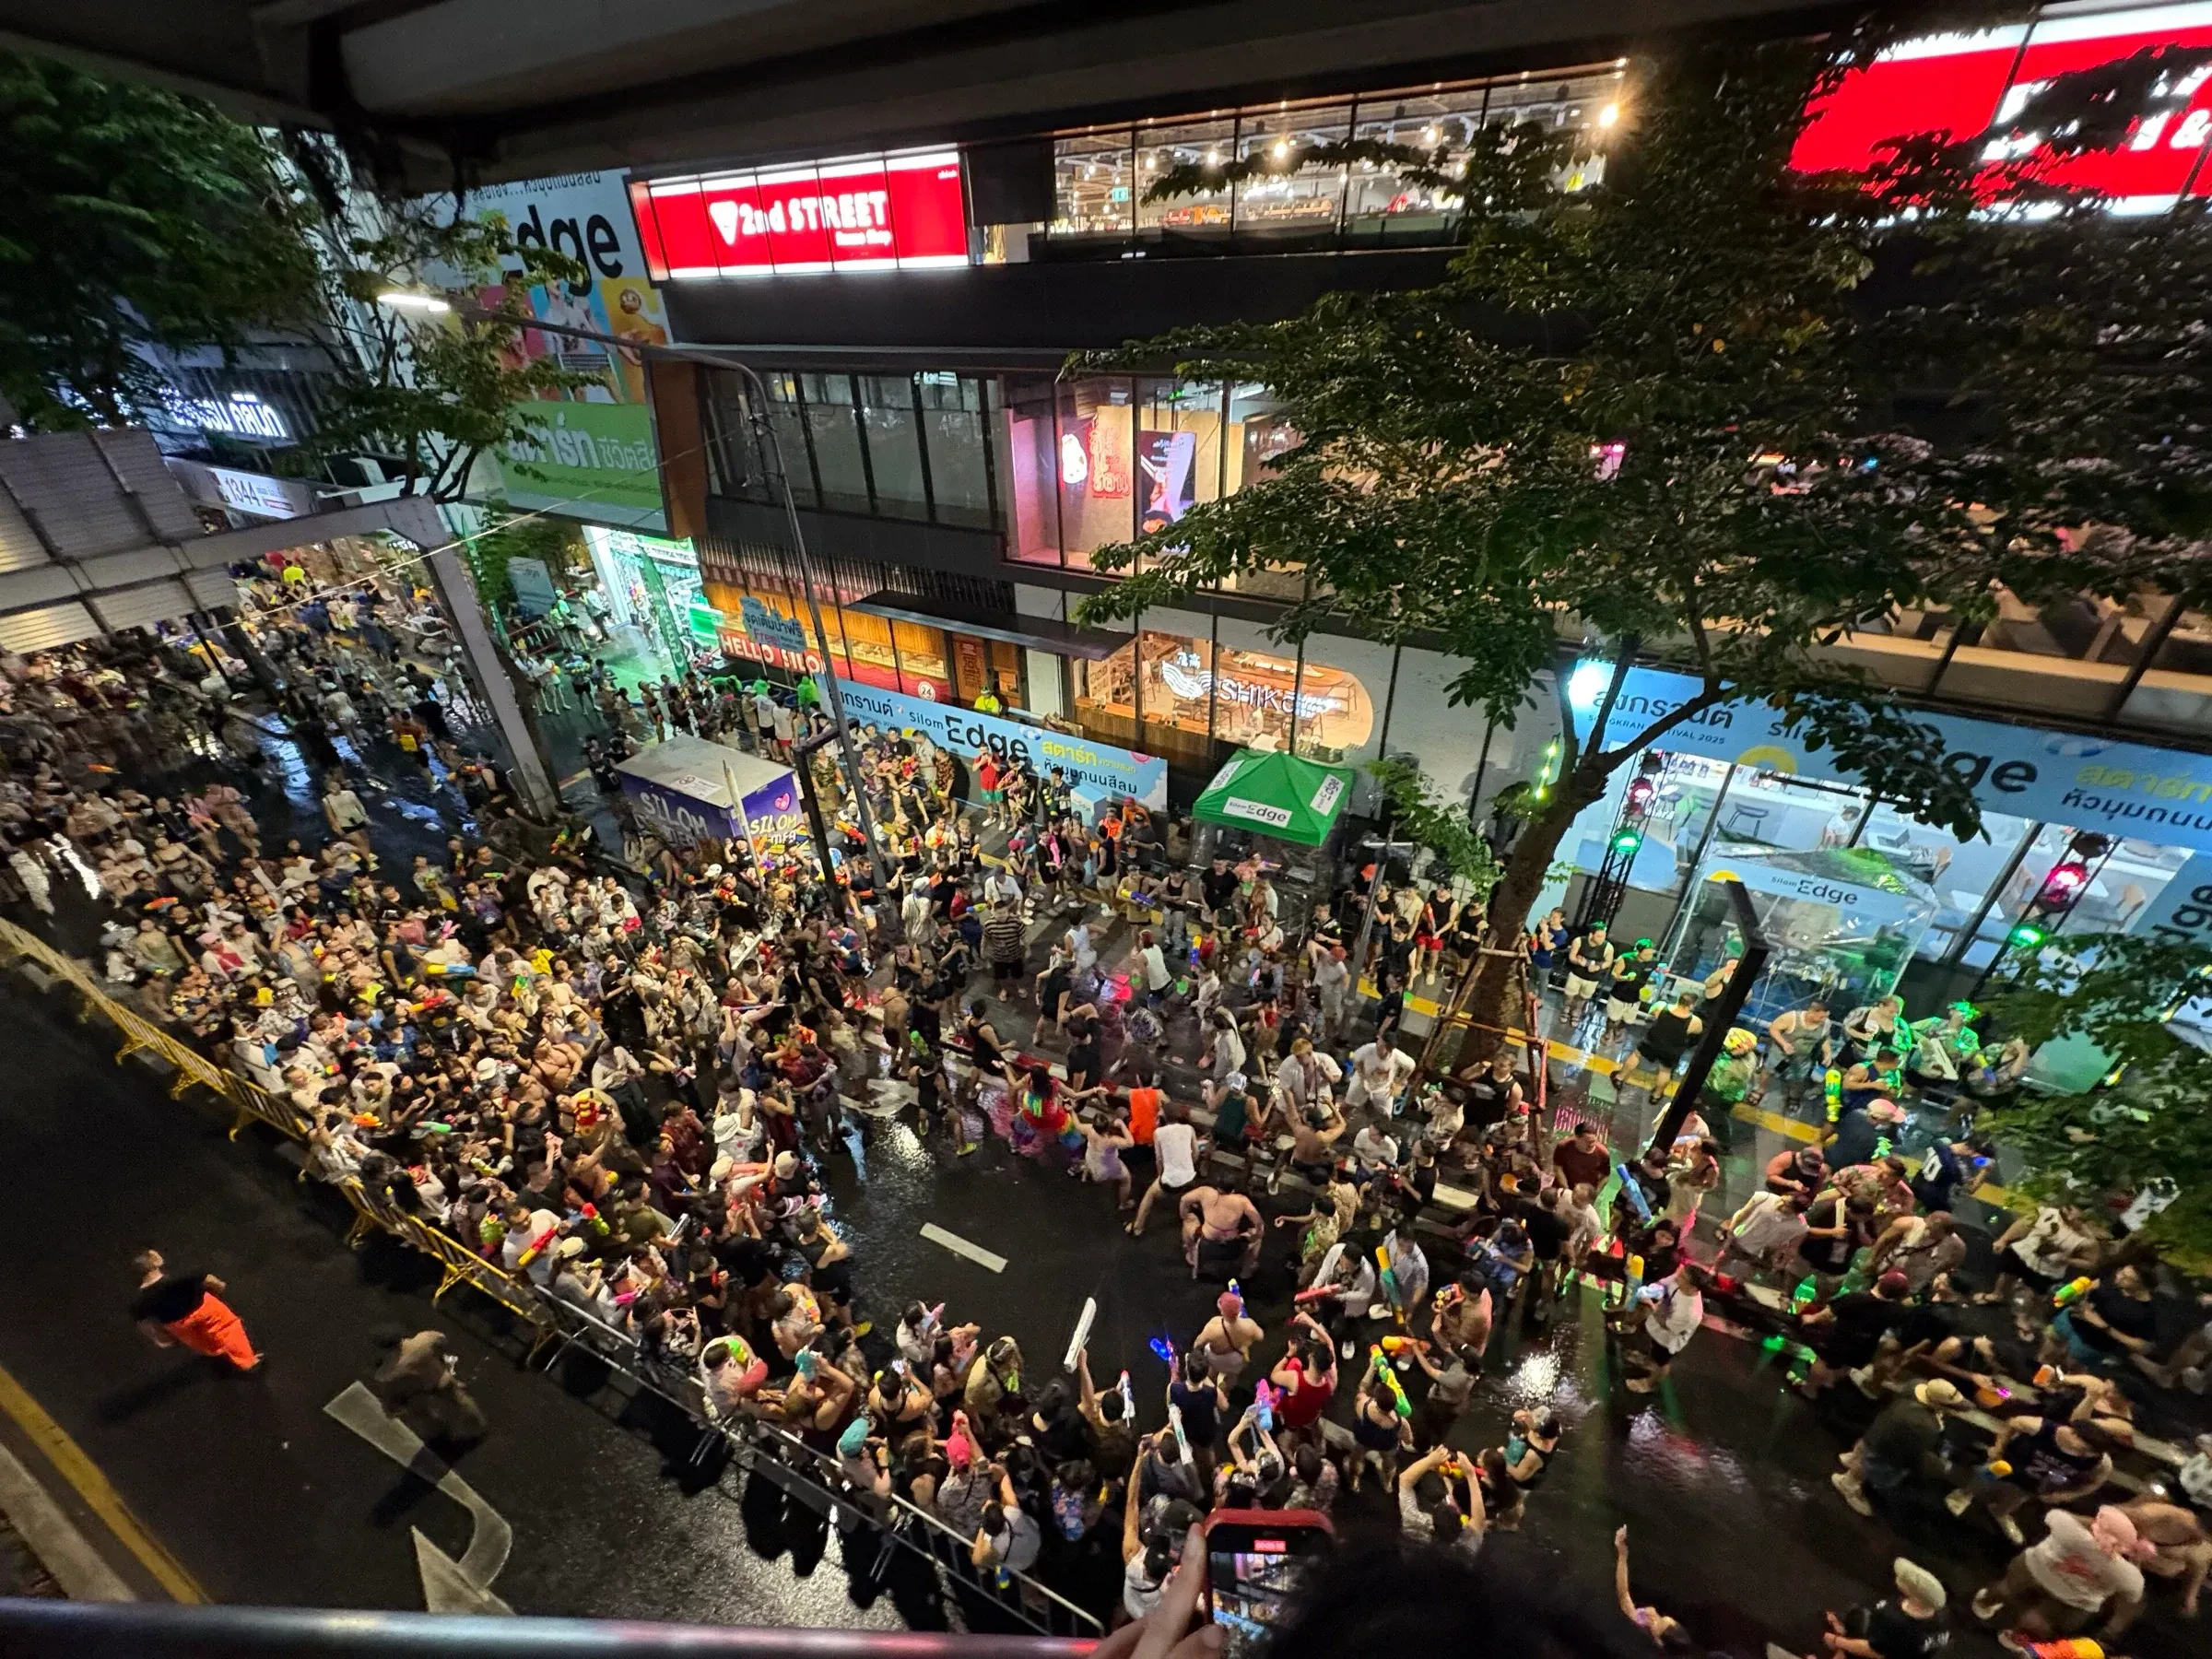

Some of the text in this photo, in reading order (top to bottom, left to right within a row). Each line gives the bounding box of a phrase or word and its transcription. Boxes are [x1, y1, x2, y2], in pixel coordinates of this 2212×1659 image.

[738, 190, 887, 235] 2nd STREET
[721, 634, 774, 664] HELLO
[910, 711, 1029, 761] Silom Edge
[1041, 738, 1098, 768] สตาร์ท
[640, 792, 710, 838] SILOM
[750, 814, 797, 835] SILOM
[1246, 804, 1288, 823] Edge
[1771, 876, 1858, 904] Silom Edge
